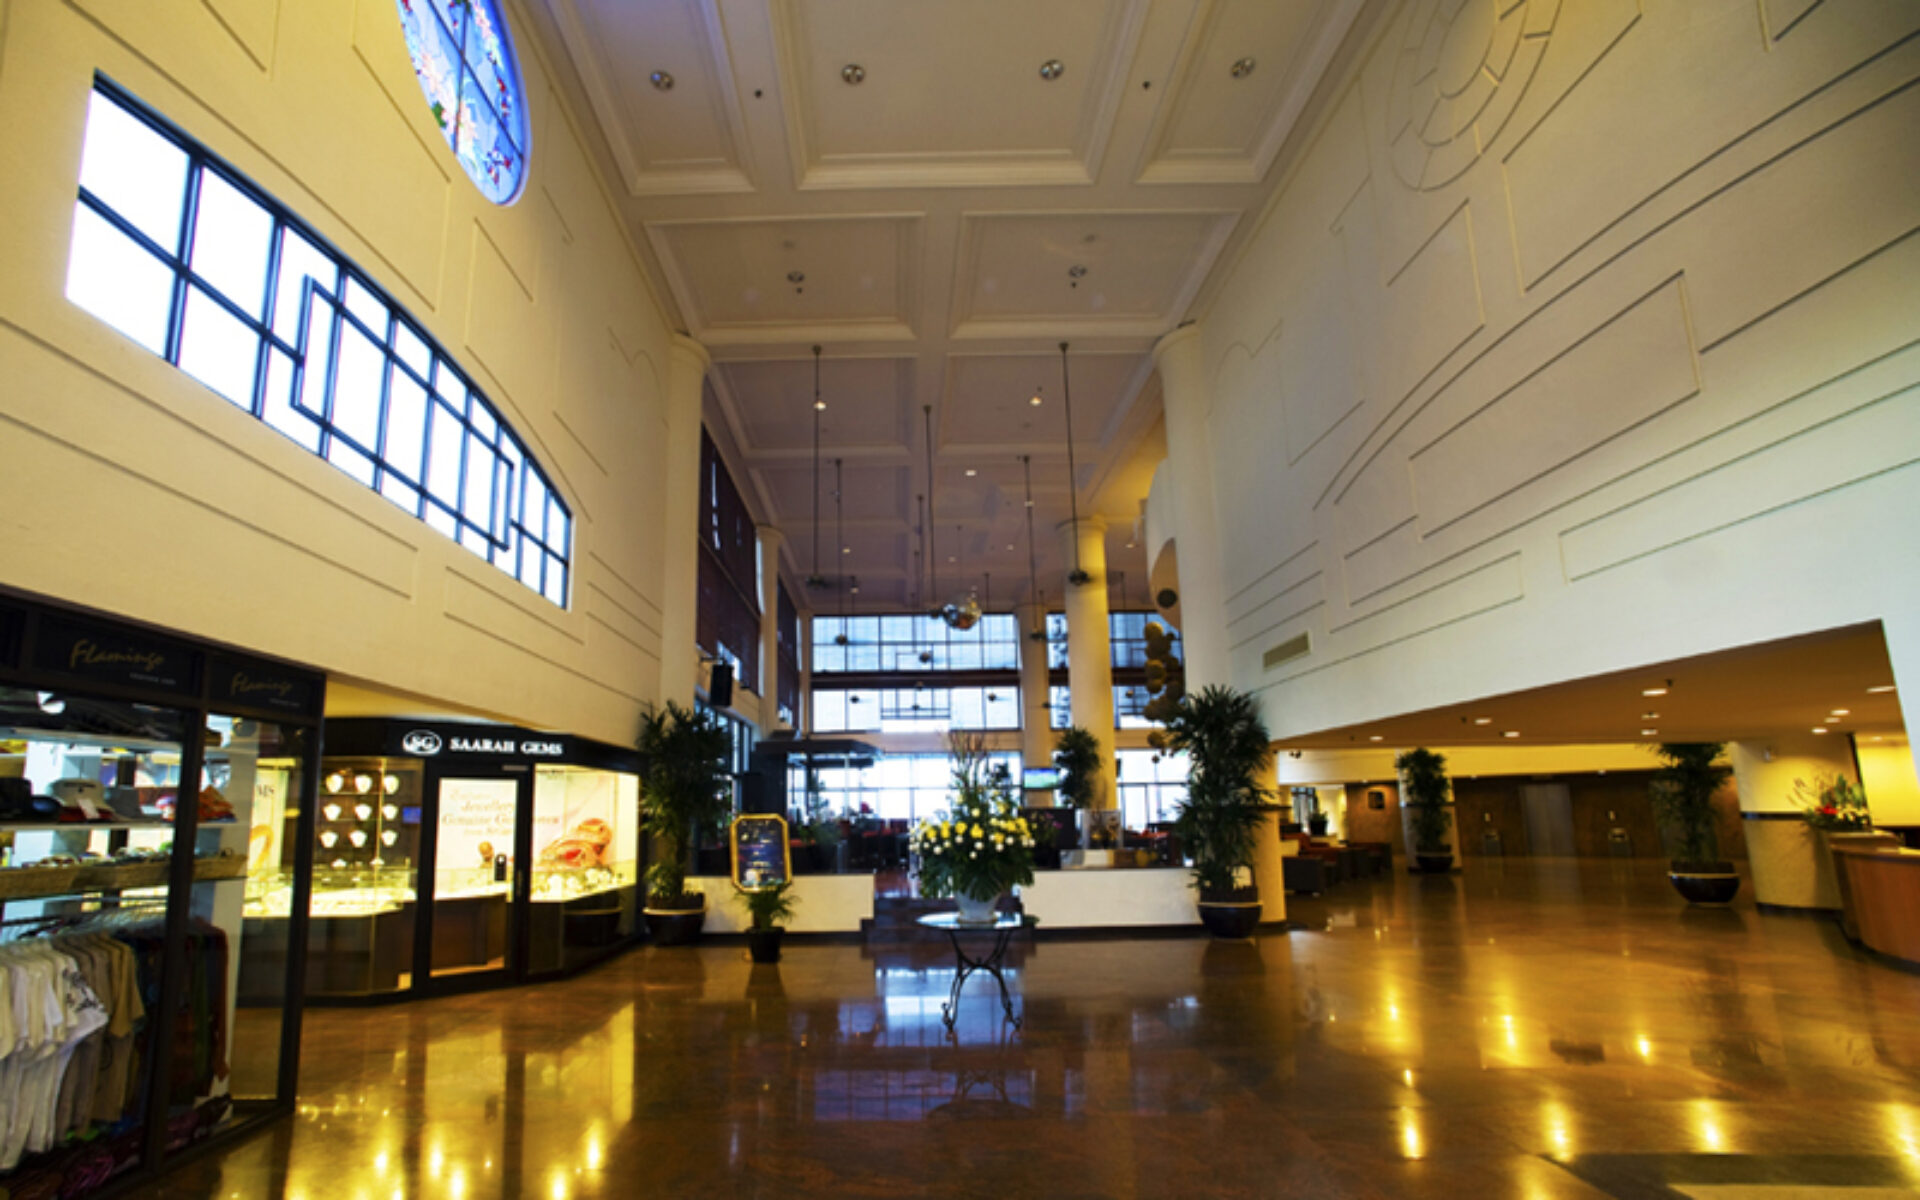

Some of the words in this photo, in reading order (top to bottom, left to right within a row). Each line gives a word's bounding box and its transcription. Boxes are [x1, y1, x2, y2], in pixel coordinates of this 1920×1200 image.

[69, 638, 165, 671] Flamingo
[230, 672, 294, 697] Flamingo
[449, 737, 515, 752] SAARAH
[520, 741, 563, 755] GEMS
